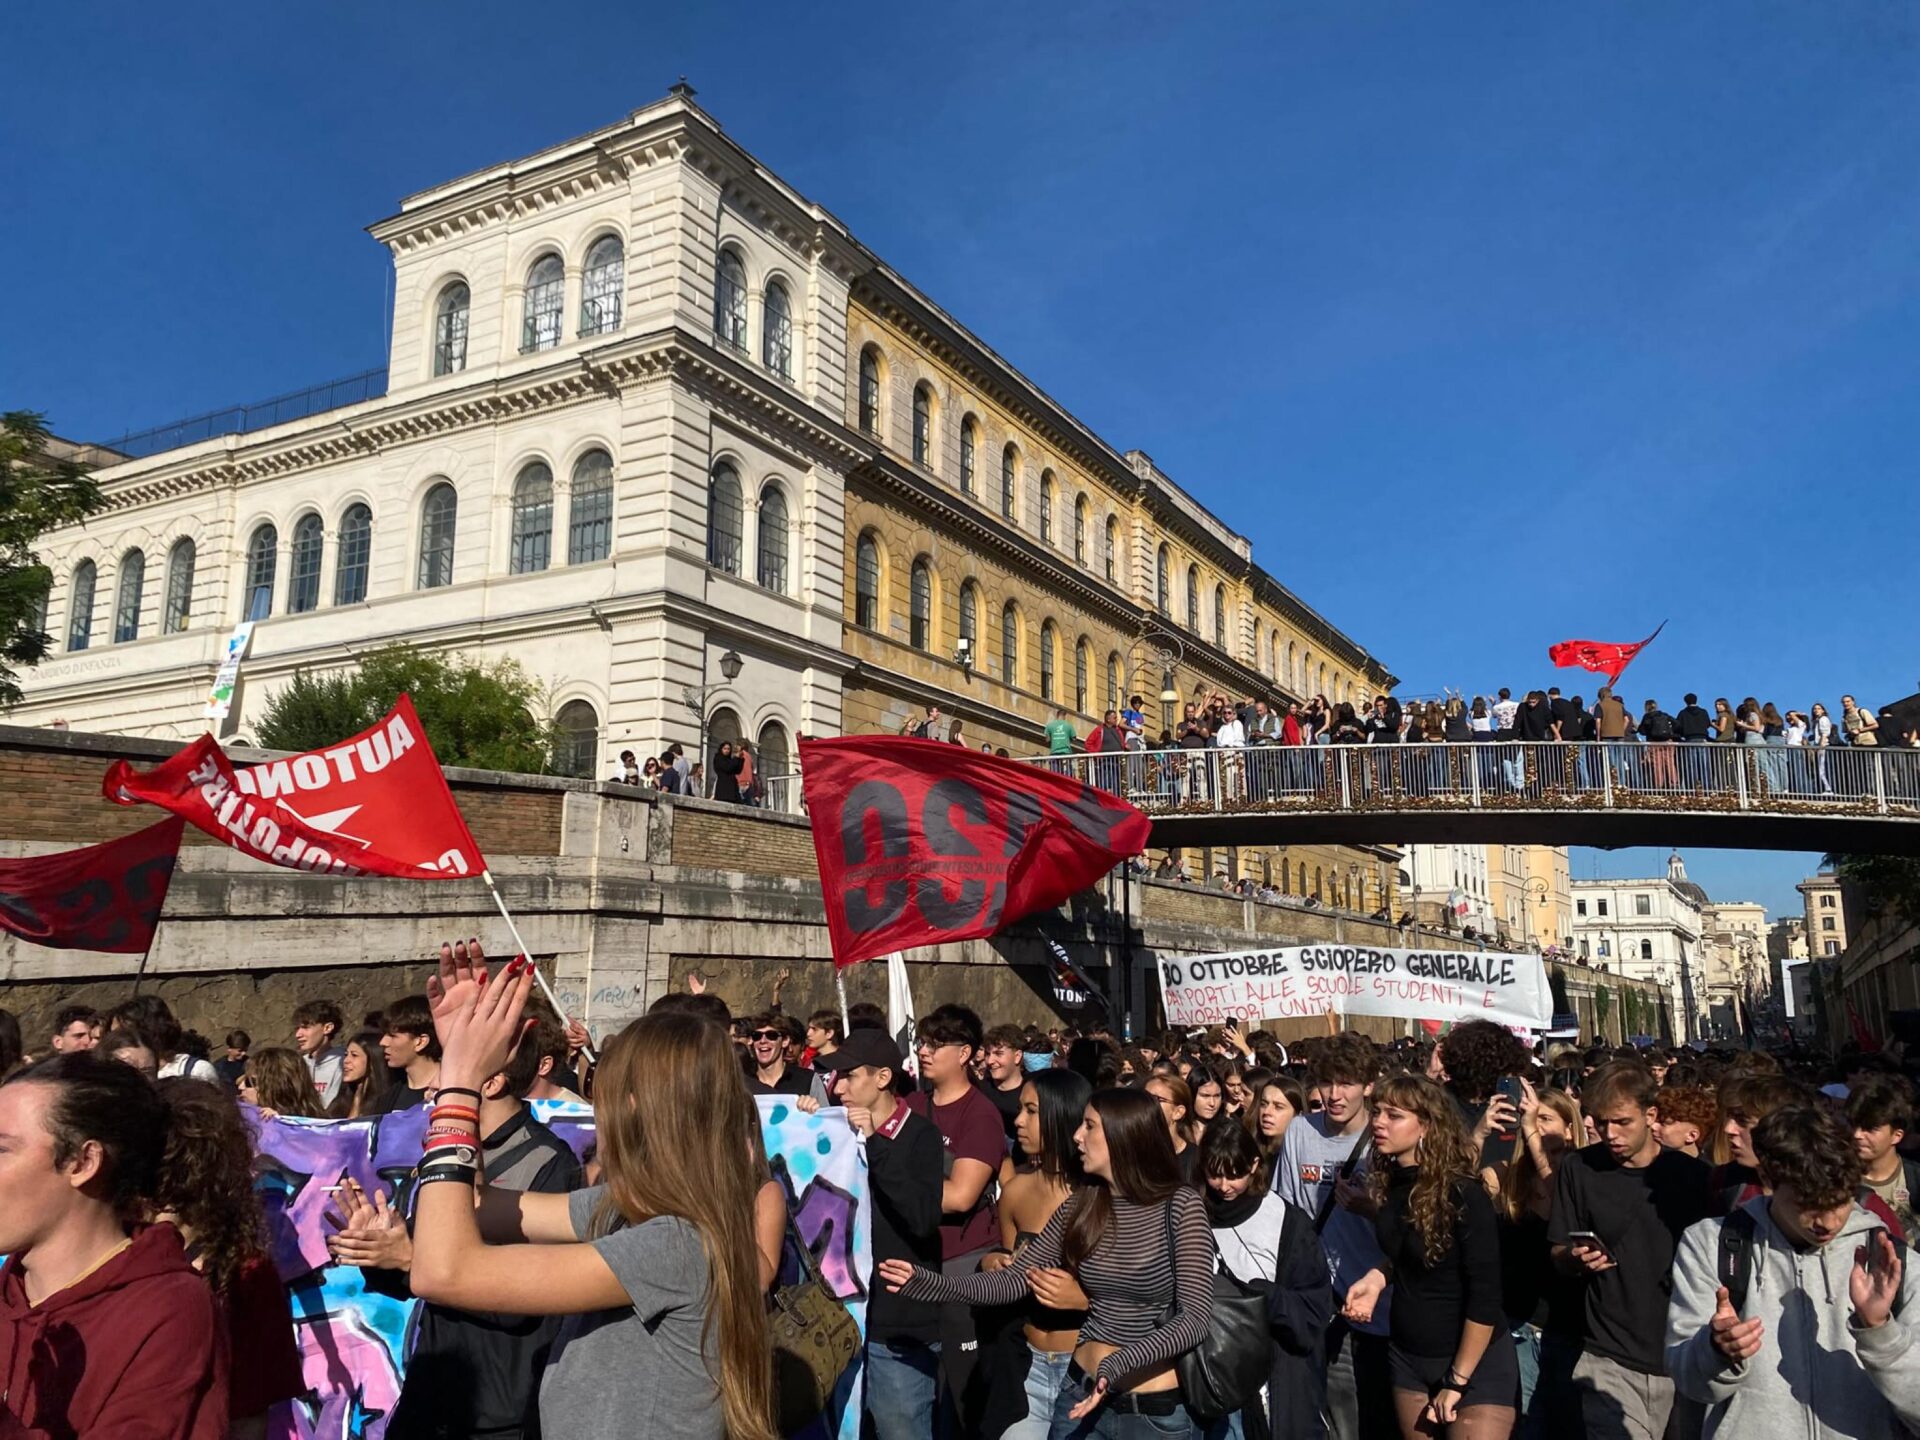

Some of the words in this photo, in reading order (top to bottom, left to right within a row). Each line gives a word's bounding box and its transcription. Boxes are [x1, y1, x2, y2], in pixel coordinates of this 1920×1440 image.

[1190, 952, 1288, 981] OTTOBRE
[1405, 953, 1515, 986] GENERALE
[1246, 976, 1296, 1002] ALLE
[1307, 975, 1365, 995] SCUOLE
[1482, 990, 1496, 1008] E
[426, 1125, 467, 1136] PAMPLONA
